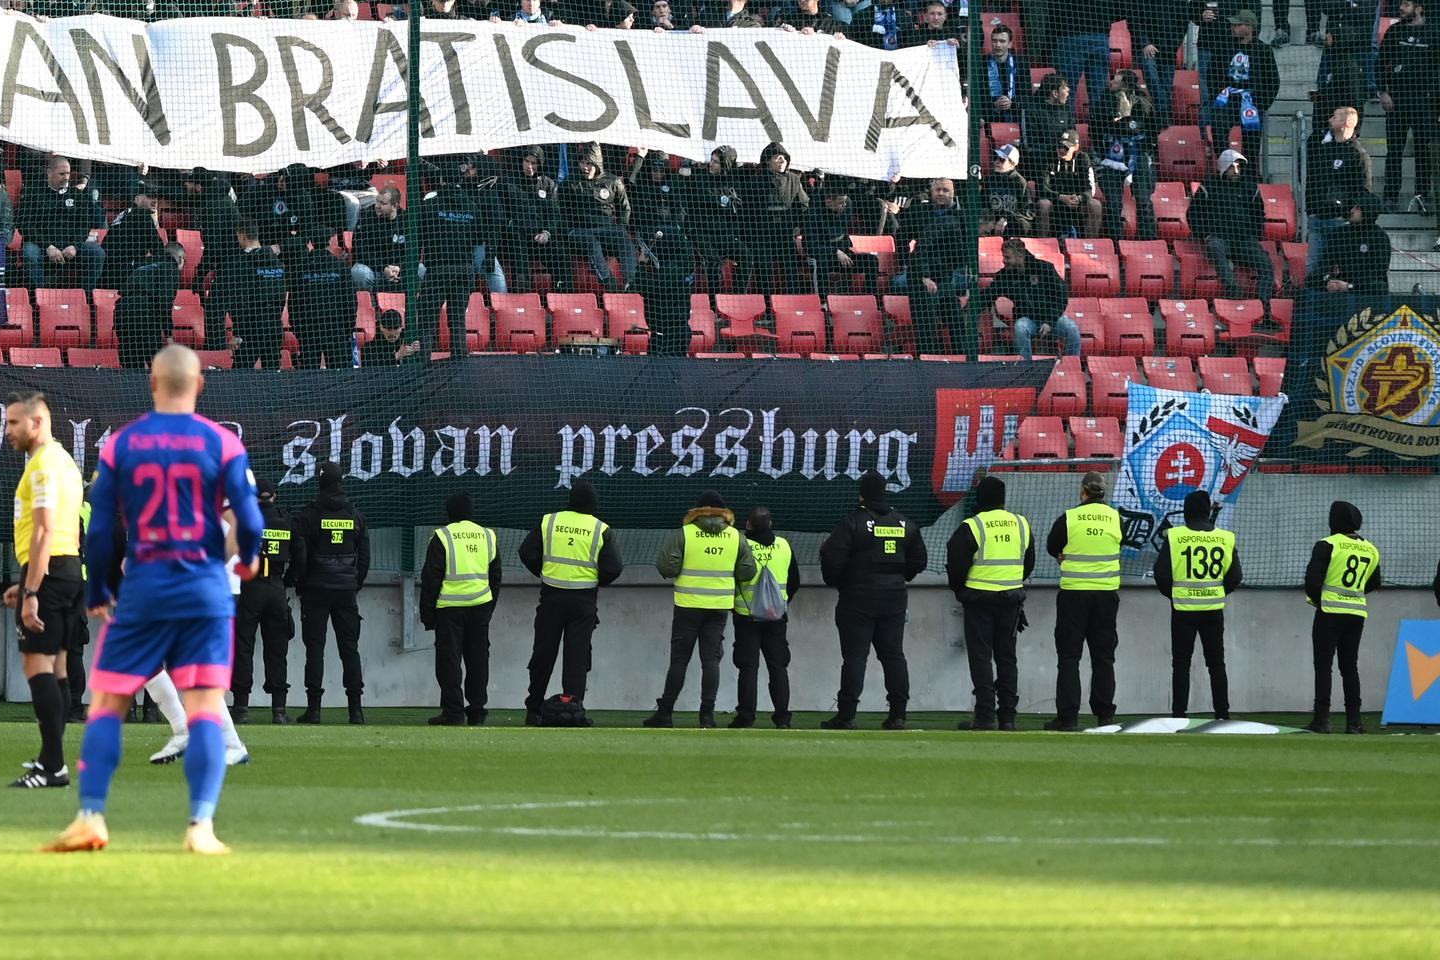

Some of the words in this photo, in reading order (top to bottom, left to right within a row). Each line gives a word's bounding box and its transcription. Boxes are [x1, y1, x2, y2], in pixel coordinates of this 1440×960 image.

[212, 27, 954, 158] BRATISLAVA
[1367, 332, 1413, 355] SLOVAN
[553, 406, 918, 493] pressburg
[132, 461, 206, 542] 20
[1077, 513, 1112, 522] SECURITY
[985, 520, 1018, 528] SECURITY
[262, 530, 290, 539] ECURITY
[555, 524, 592, 537] SECURITY
[695, 530, 731, 539] SECURITY
[875, 527, 904, 536] SECURITY
[1086, 528, 1104, 536] 507
[452, 532, 485, 540] SECURITY
[993, 534, 1011, 543] 118
[568, 537, 574, 546] 2
[268, 542, 279, 552] 54
[465, 544, 478, 553] 166
[704, 546, 724, 556] 407
[1180, 545, 1225, 580] 138
[1341, 553, 1371, 589] 87
[1187, 588, 1219, 597] STEWARD
